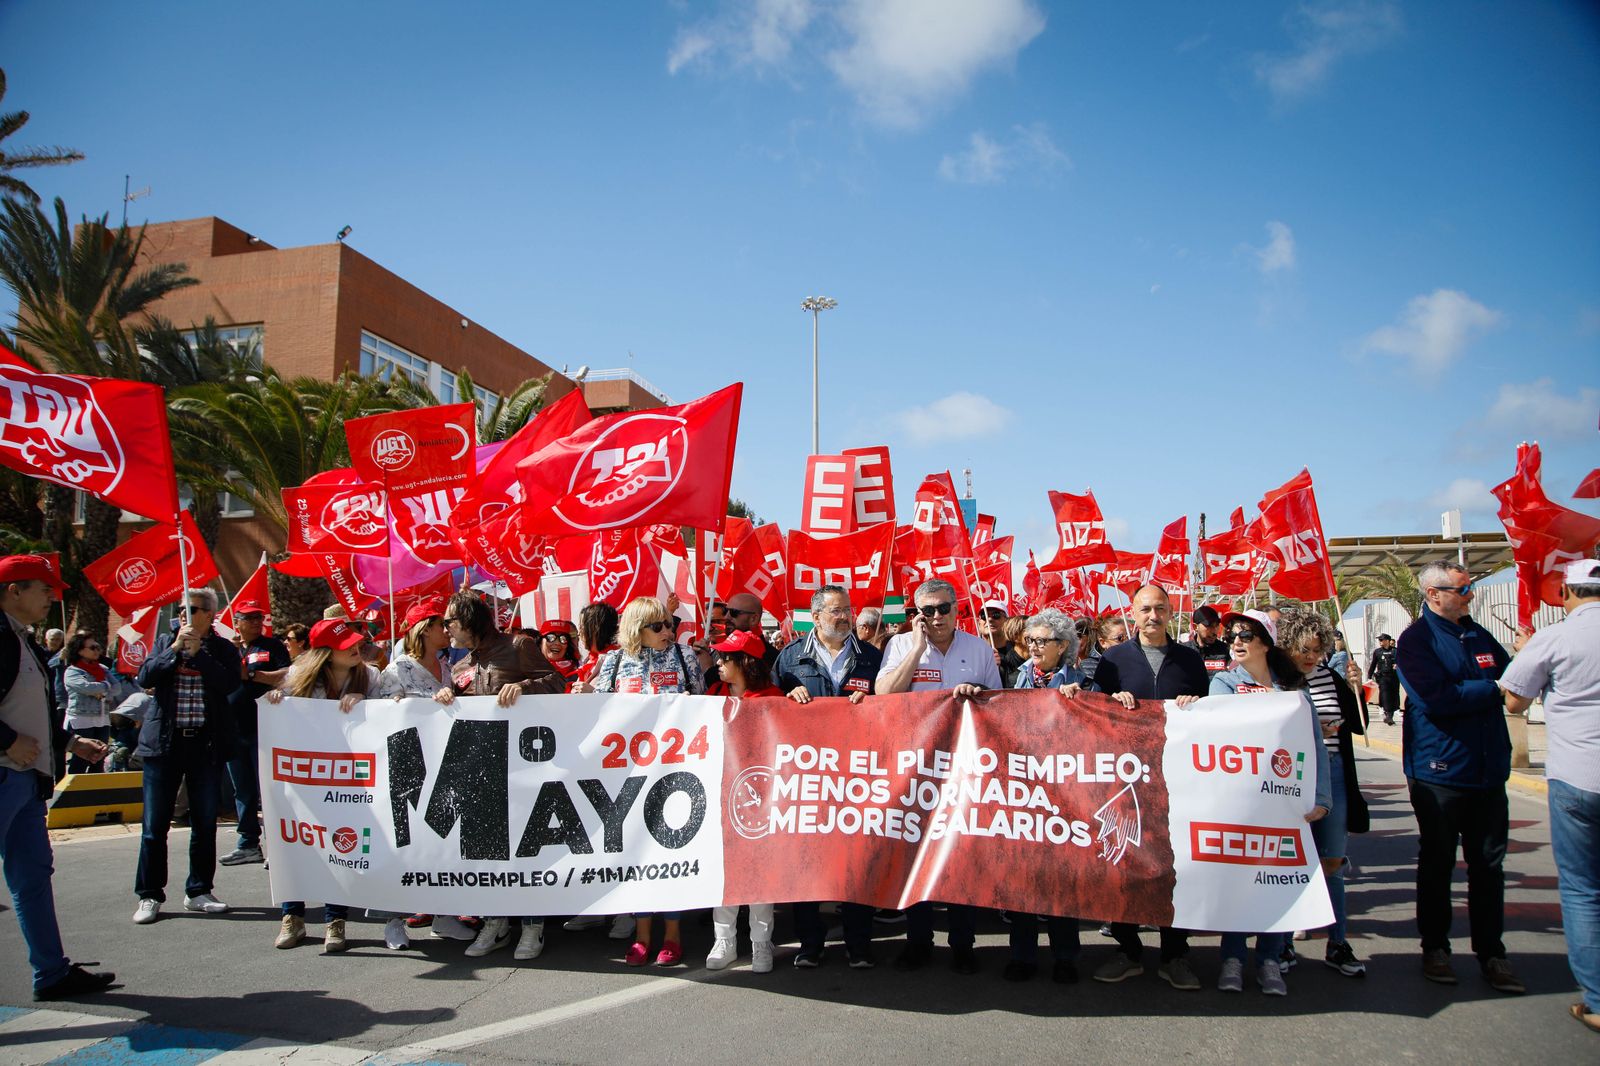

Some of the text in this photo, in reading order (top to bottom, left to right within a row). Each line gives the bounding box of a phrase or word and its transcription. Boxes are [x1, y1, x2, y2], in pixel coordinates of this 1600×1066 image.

[377, 435, 408, 456] UGT
[391, 473, 467, 491] www.ugt-andalucia.com
[120, 561, 150, 585] UGT
[601, 725, 709, 768] 2024
[1191, 743, 1265, 775] UGT
[277, 754, 354, 780] CCOO
[774, 744, 839, 772] POR
[849, 750, 888, 775] EL
[1008, 752, 1150, 784] EMPLEO:
[323, 790, 374, 804] Almería
[771, 773, 1060, 815] MENOS JORNADA,
[1260, 780, 1301, 797] Almería
[280, 818, 327, 849] UGT
[769, 805, 1092, 848] MEJORES SALARIOS
[1198, 829, 1281, 859] CCOO
[329, 853, 370, 869] Almería
[401, 871, 558, 888] #PLENOEMPLEO
[580, 859, 700, 884] #1MAYO2024
[1254, 870, 1310, 885] Almería
